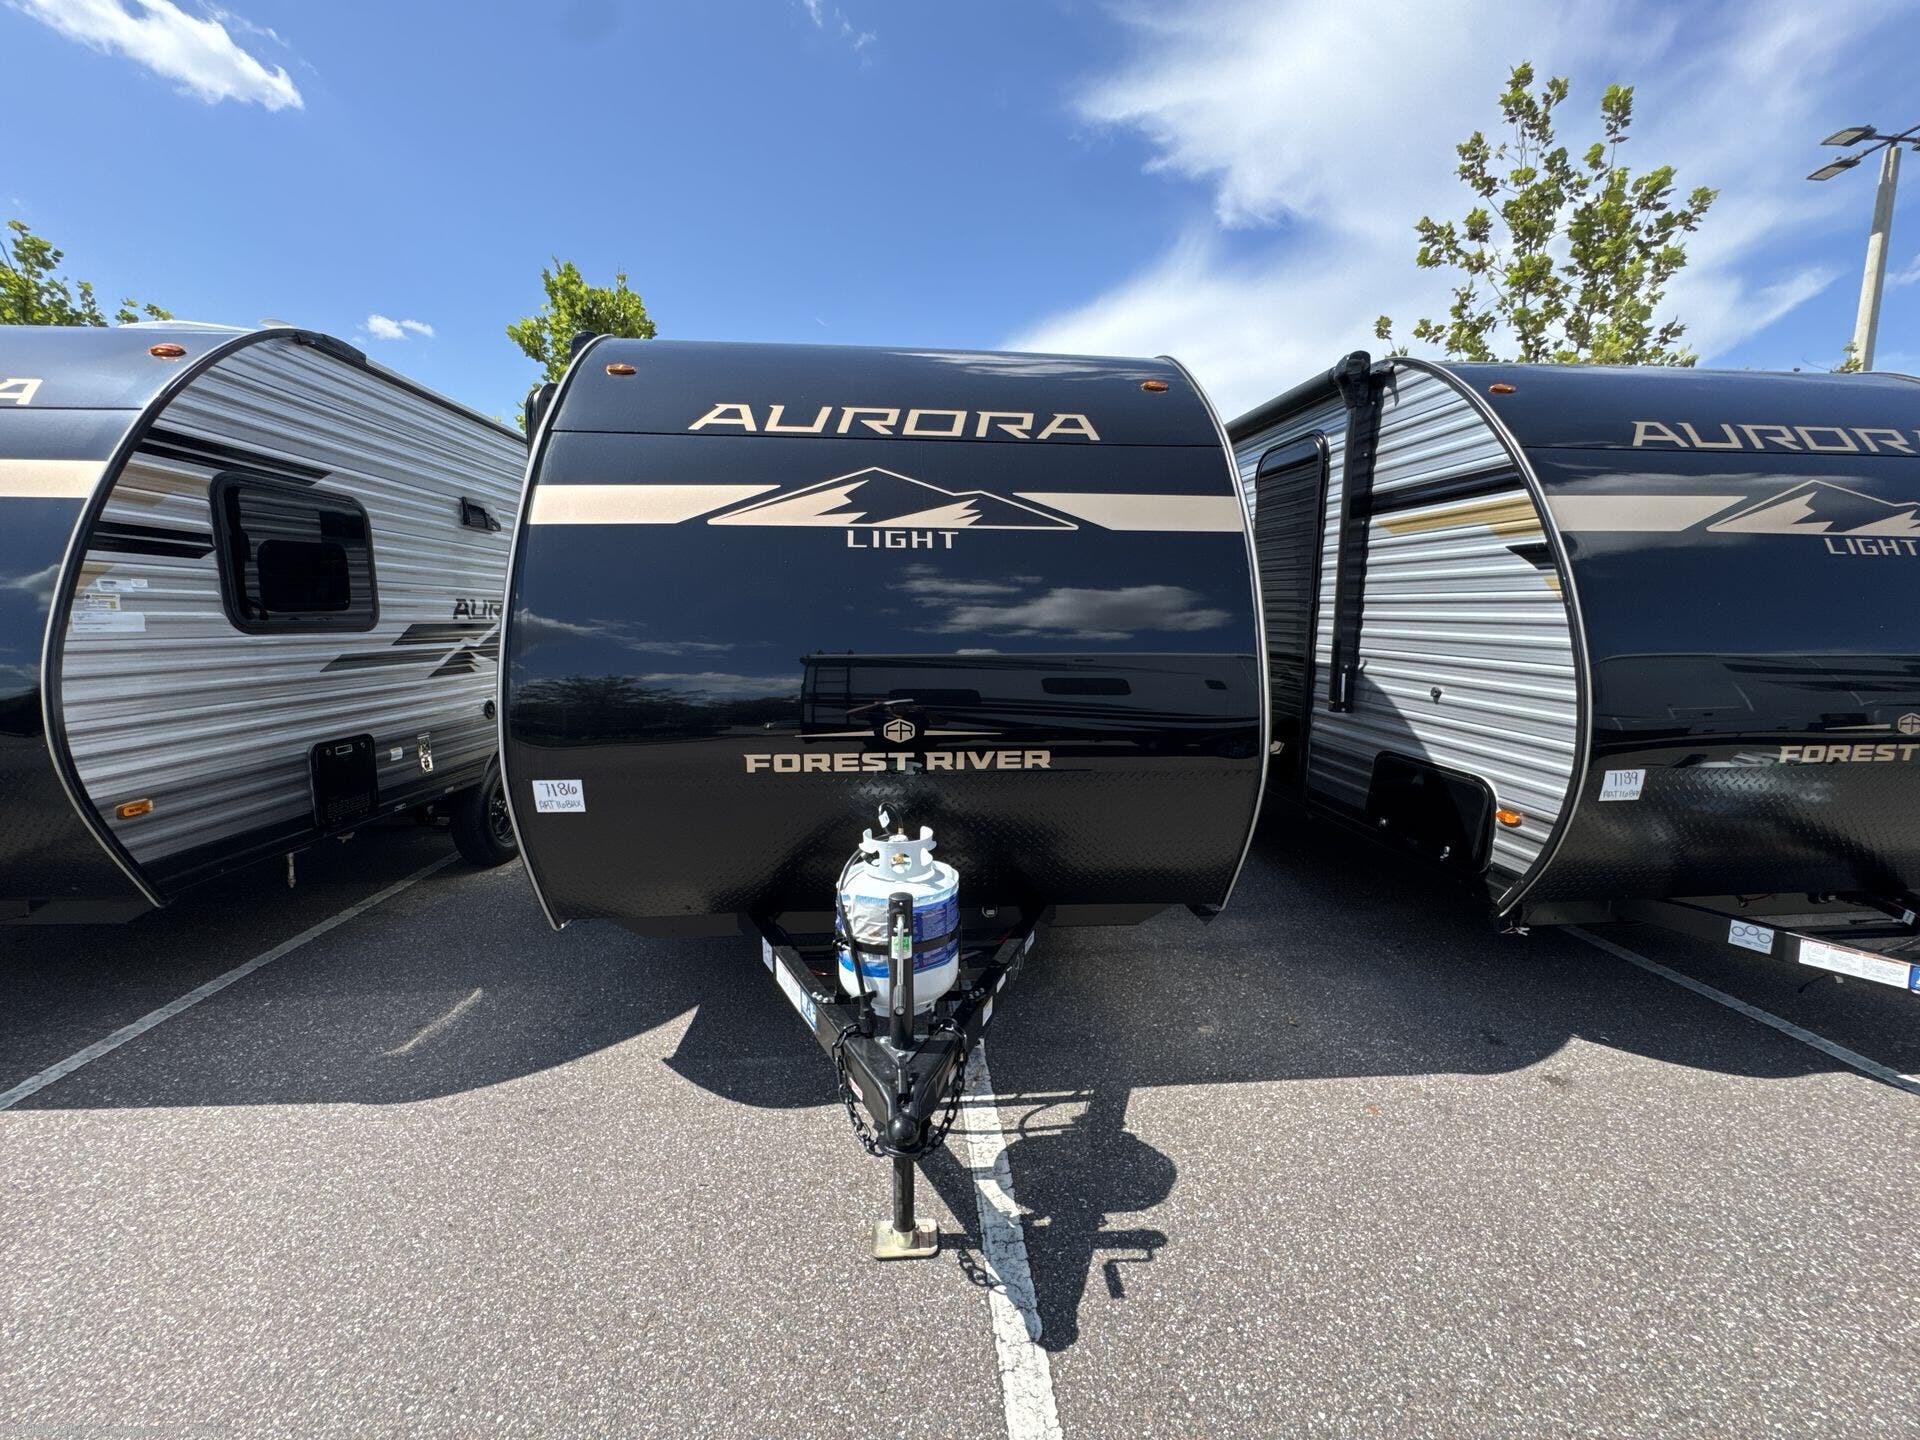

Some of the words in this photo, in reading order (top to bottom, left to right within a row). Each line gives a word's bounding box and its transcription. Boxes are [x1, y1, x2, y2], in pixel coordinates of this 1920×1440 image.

[688, 403, 1100, 441] AURORA
[1631, 421, 1920, 454] AUROR
[846, 530, 959, 549] LIGHT
[1824, 538, 1918, 556] LIGHT
[743, 752, 915, 773] FOREST
[924, 750, 1051, 771] RIVER
[1779, 744, 1920, 763] FOREST
[1610, 771, 1638, 787] 7189
[538, 782, 578, 798] 7186
